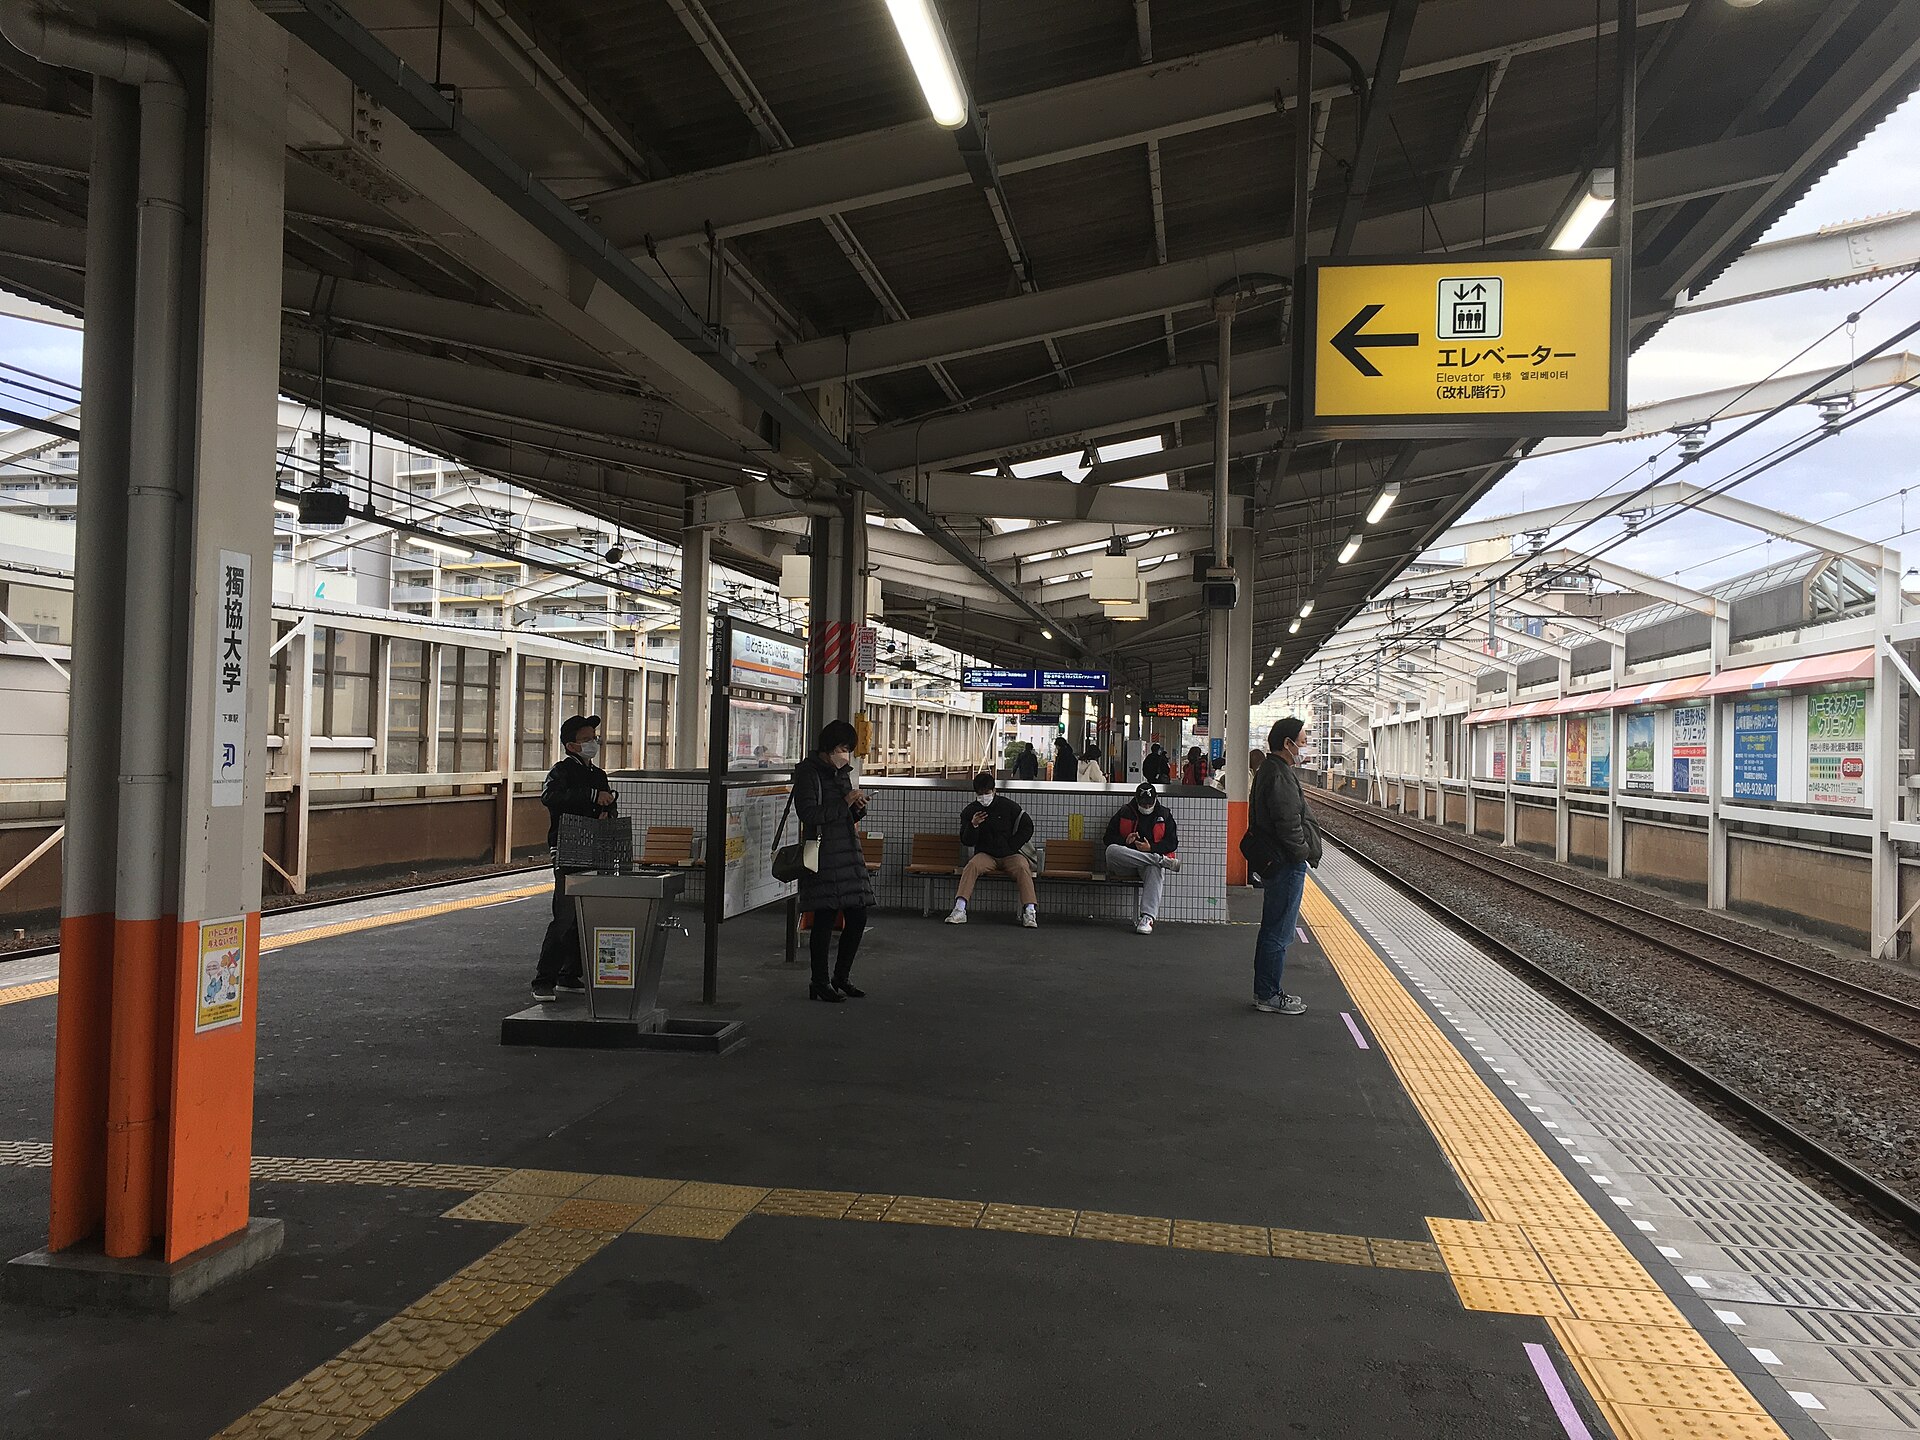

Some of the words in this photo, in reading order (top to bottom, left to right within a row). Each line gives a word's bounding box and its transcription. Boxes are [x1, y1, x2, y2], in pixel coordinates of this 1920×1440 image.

[1437, 345, 1576, 368] エレベーター
[1436, 372, 1485, 383] Elevator
[1492, 371, 1512, 382] 电梯
[1520, 370, 1569, 381] 엘리베이터
[222, 565, 244, 693] 獨協大学
[963, 672, 971, 684] 2
[1101, 674, 1106, 686] 1
[1809, 695, 1864, 717] ハーモネスタワー
[1682, 727, 1706, 740] クリニック
[1818, 715, 1856, 738] クリニック
[1741, 782, 1777, 797] 048-928-0011
